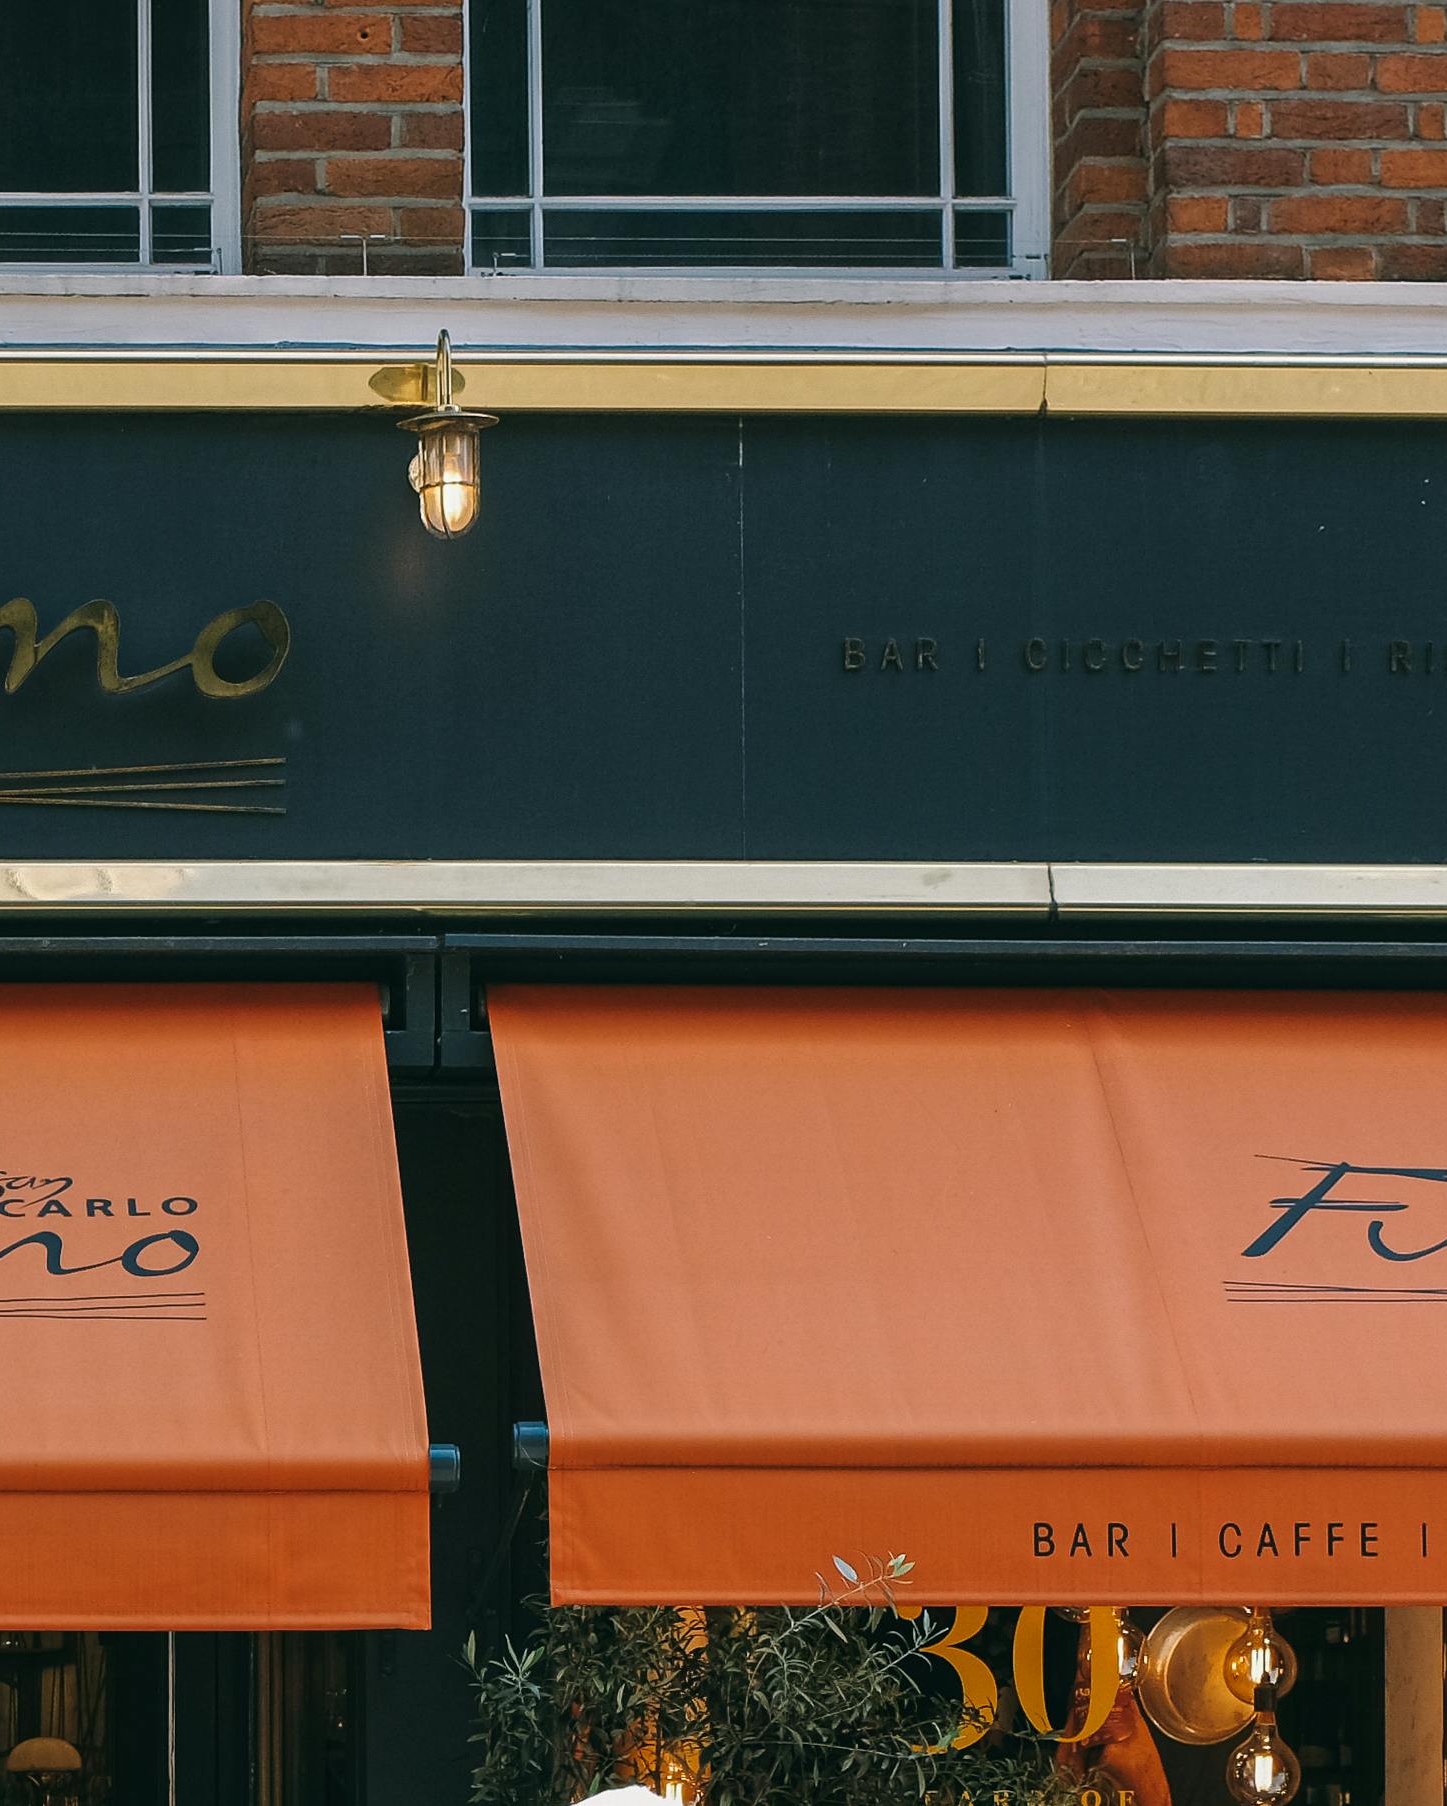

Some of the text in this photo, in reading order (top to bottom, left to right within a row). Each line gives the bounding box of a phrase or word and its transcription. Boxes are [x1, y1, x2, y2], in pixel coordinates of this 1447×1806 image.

[843, 636, 940, 672] BAR
[1023, 637, 1305, 674] CICCHETTI
[1033, 1522, 1130, 1558] BAR
[1218, 1522, 1380, 1558] CAFFE
